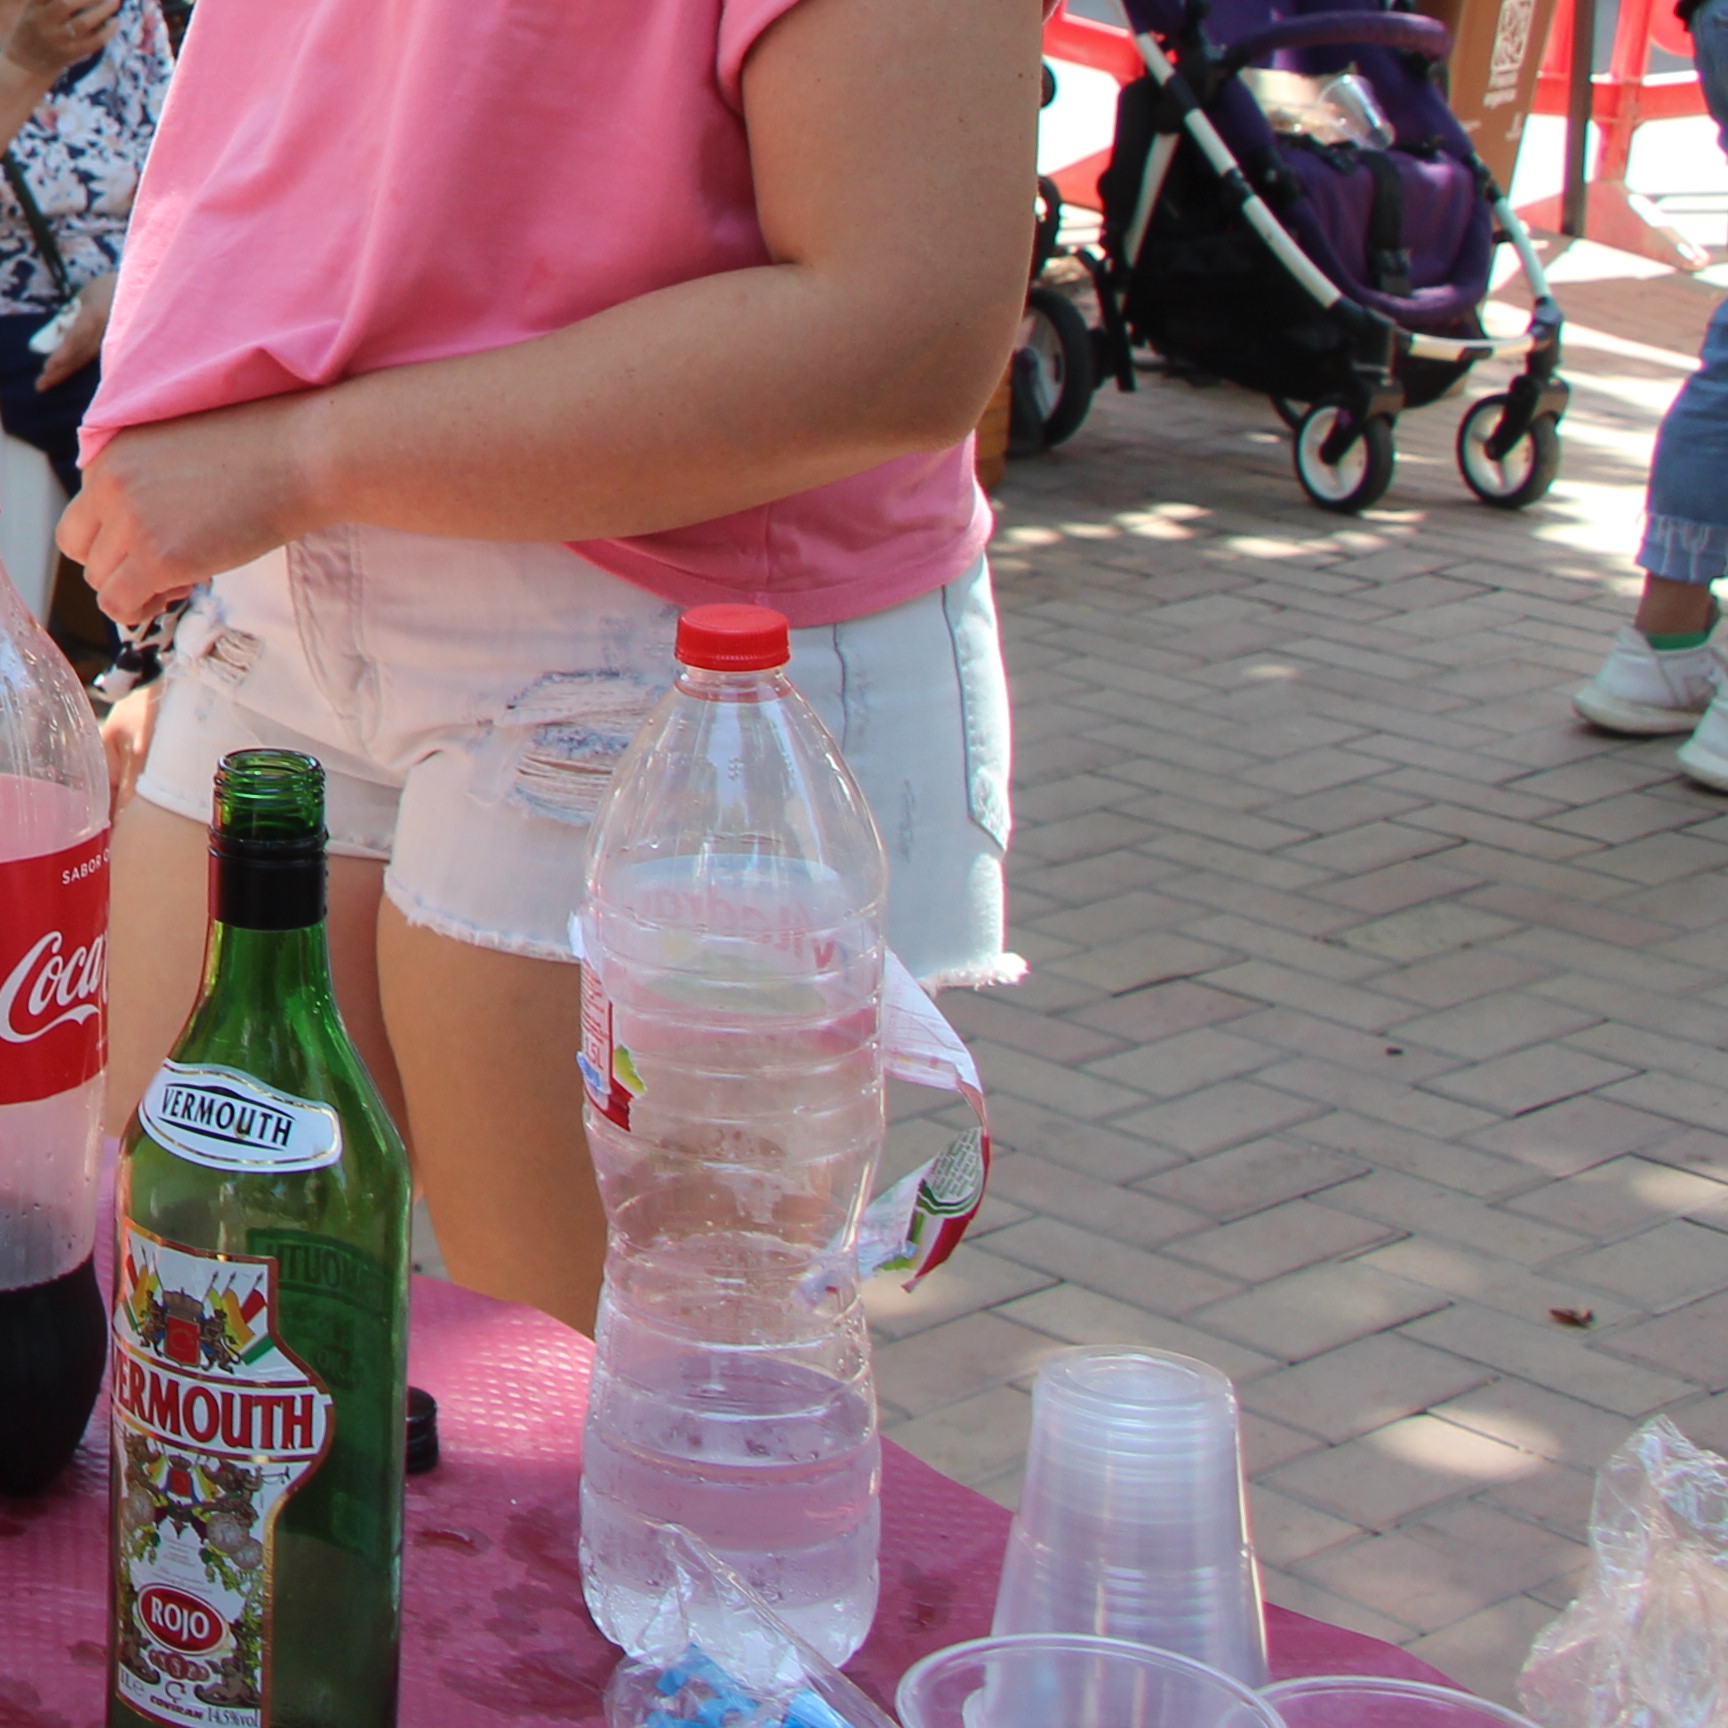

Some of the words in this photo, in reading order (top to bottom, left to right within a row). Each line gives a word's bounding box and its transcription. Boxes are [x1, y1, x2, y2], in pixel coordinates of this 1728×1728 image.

[62, 857, 102, 885] SABOR
[161, 1086, 294, 1147] VERMOUTH
[113, 1344, 315, 1451] VERMOUTH
[150, 1595, 211, 1642] ROJO
